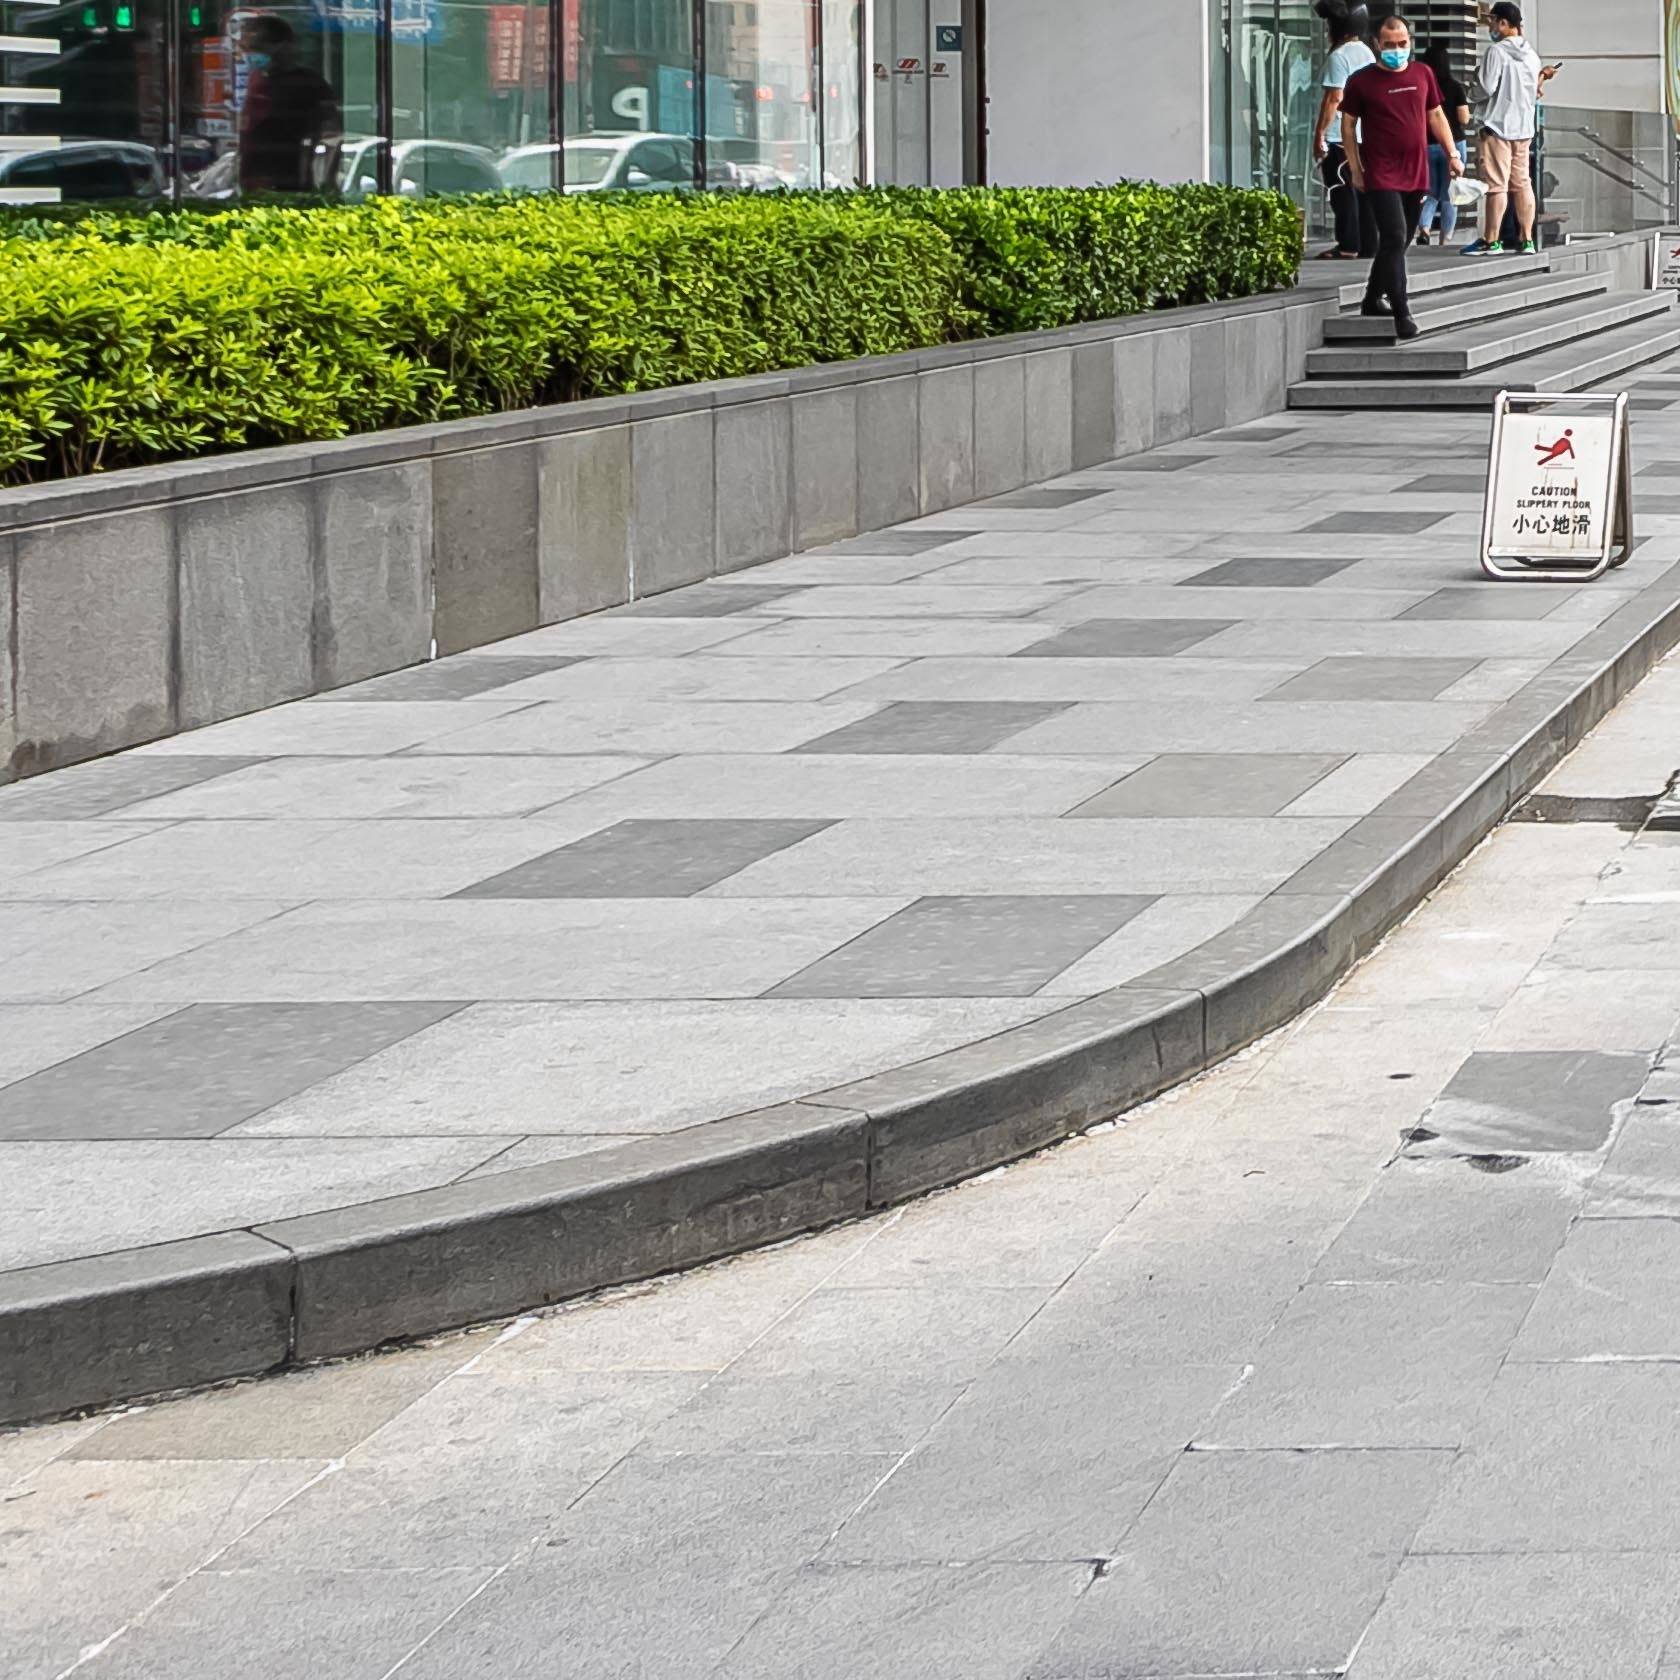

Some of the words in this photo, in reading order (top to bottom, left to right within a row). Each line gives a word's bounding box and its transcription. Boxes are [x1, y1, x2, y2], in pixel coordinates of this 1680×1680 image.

[1531, 486, 1577, 496] CAUTION
[1516, 499, 1558, 509] SLIPPERY
[1562, 500, 1591, 509] FLOOR
[1512, 513, 1592, 535] 小心地滑
